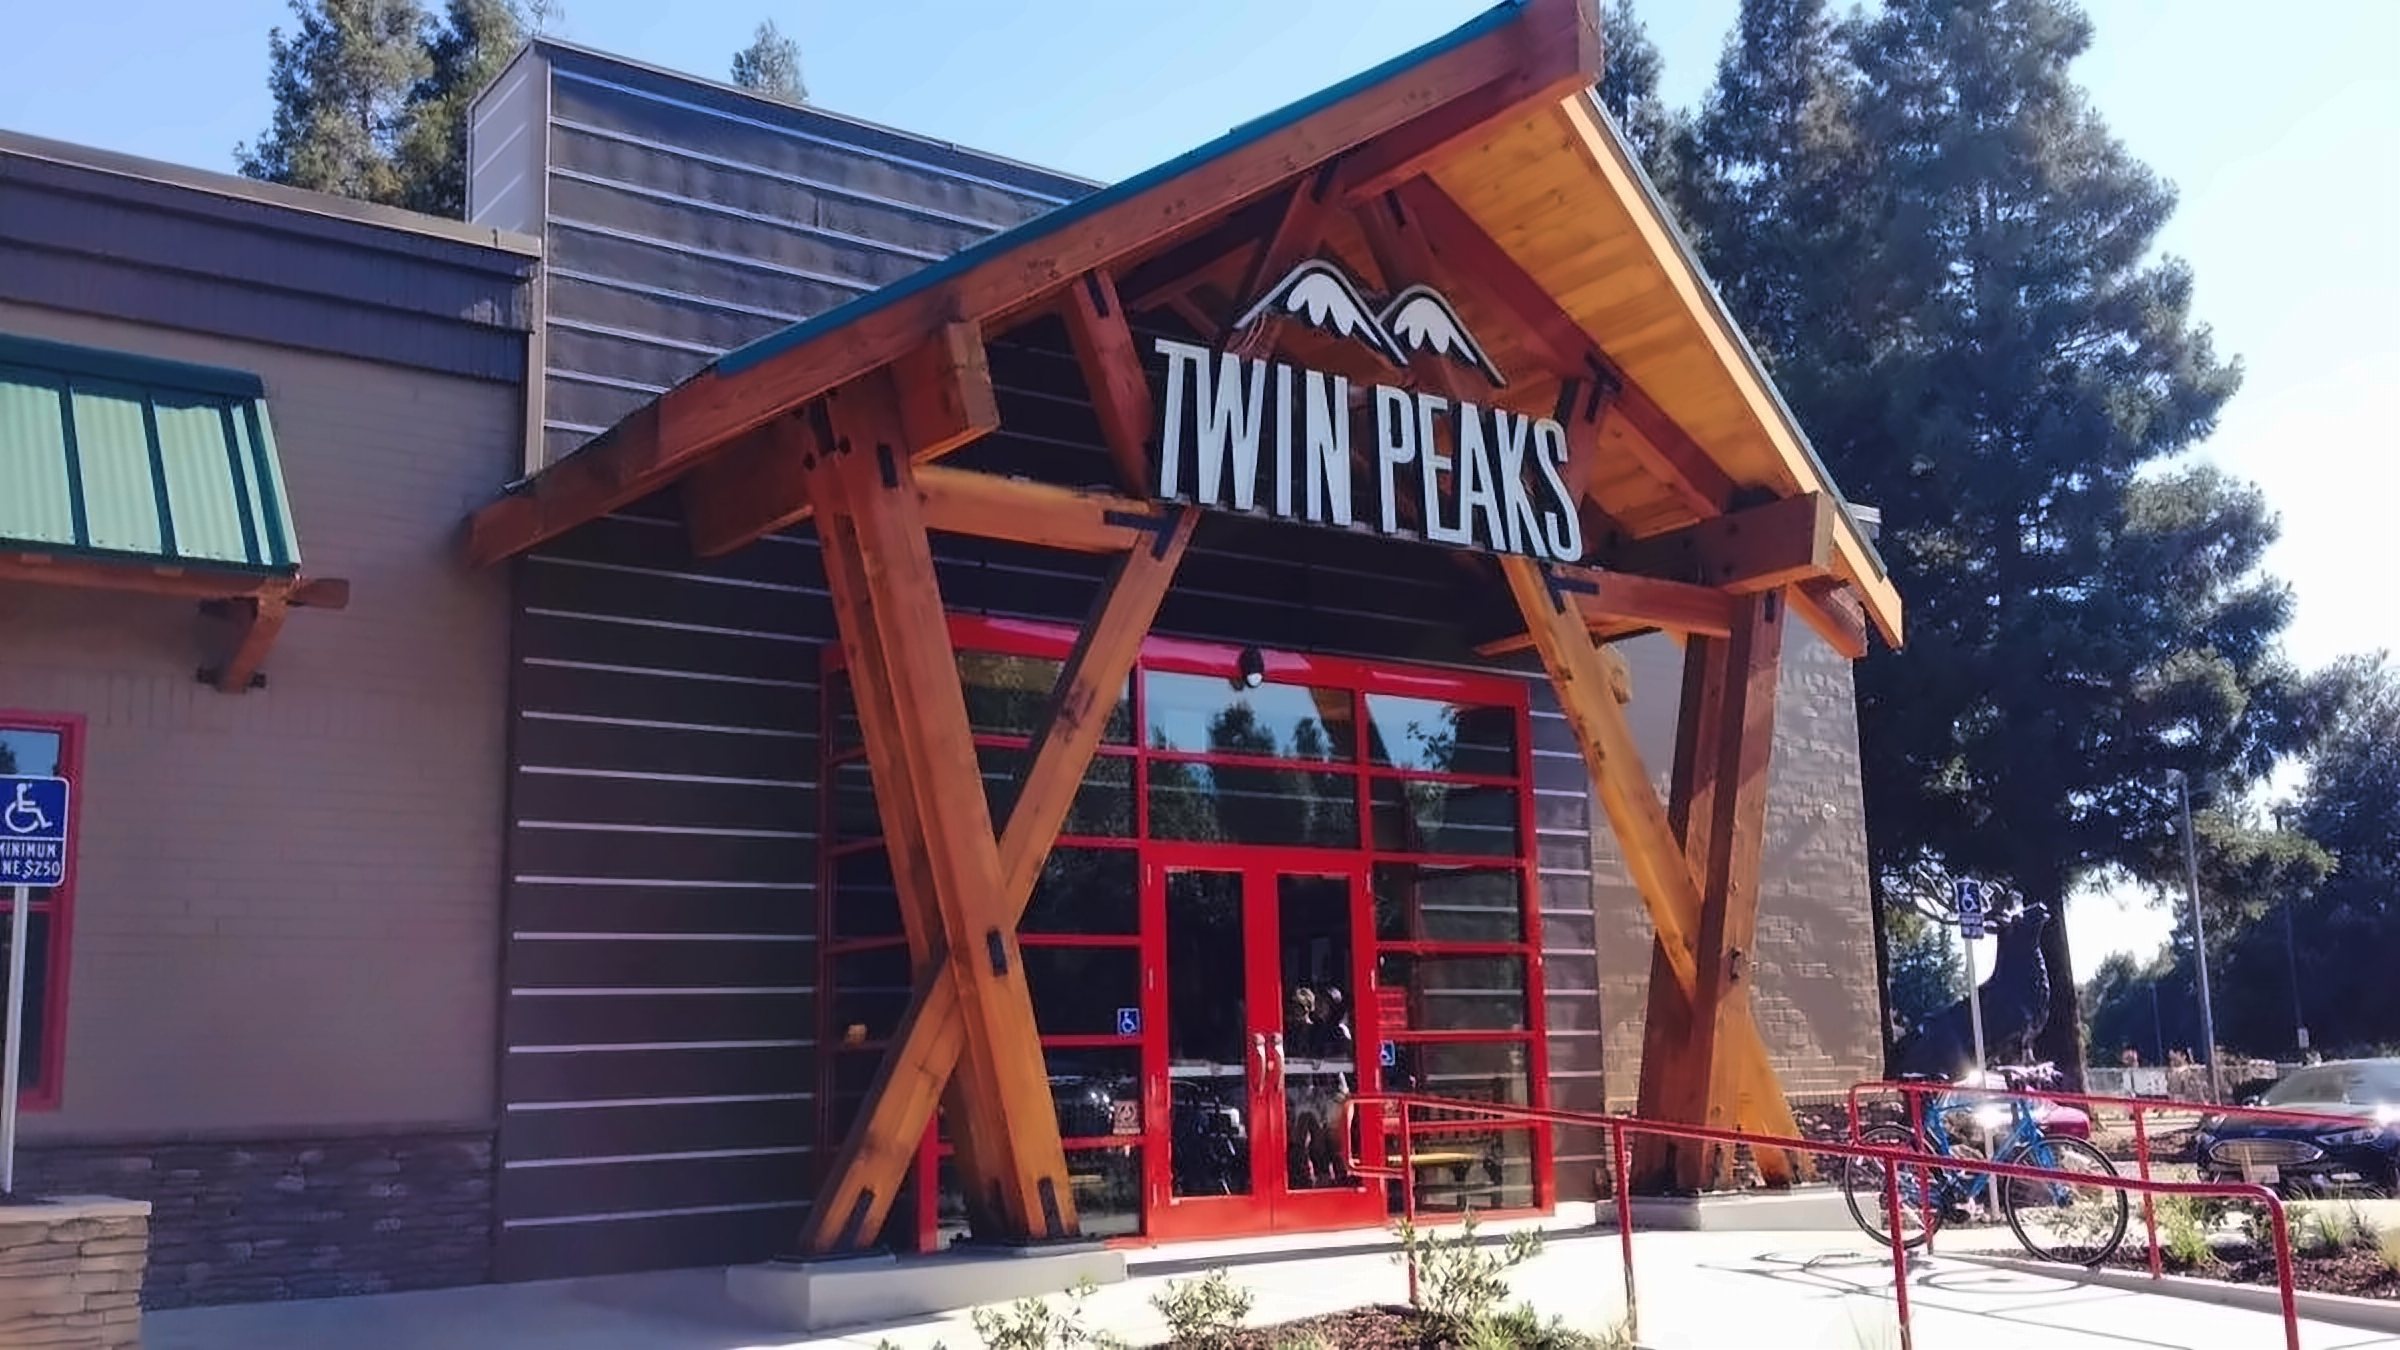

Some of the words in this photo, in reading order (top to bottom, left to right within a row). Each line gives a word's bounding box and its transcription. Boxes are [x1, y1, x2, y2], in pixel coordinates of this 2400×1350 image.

[1155, 338, 1352, 526] TWIN
[1376, 384, 1582, 561] PEAKS
[22, 859, 60, 878] $250
